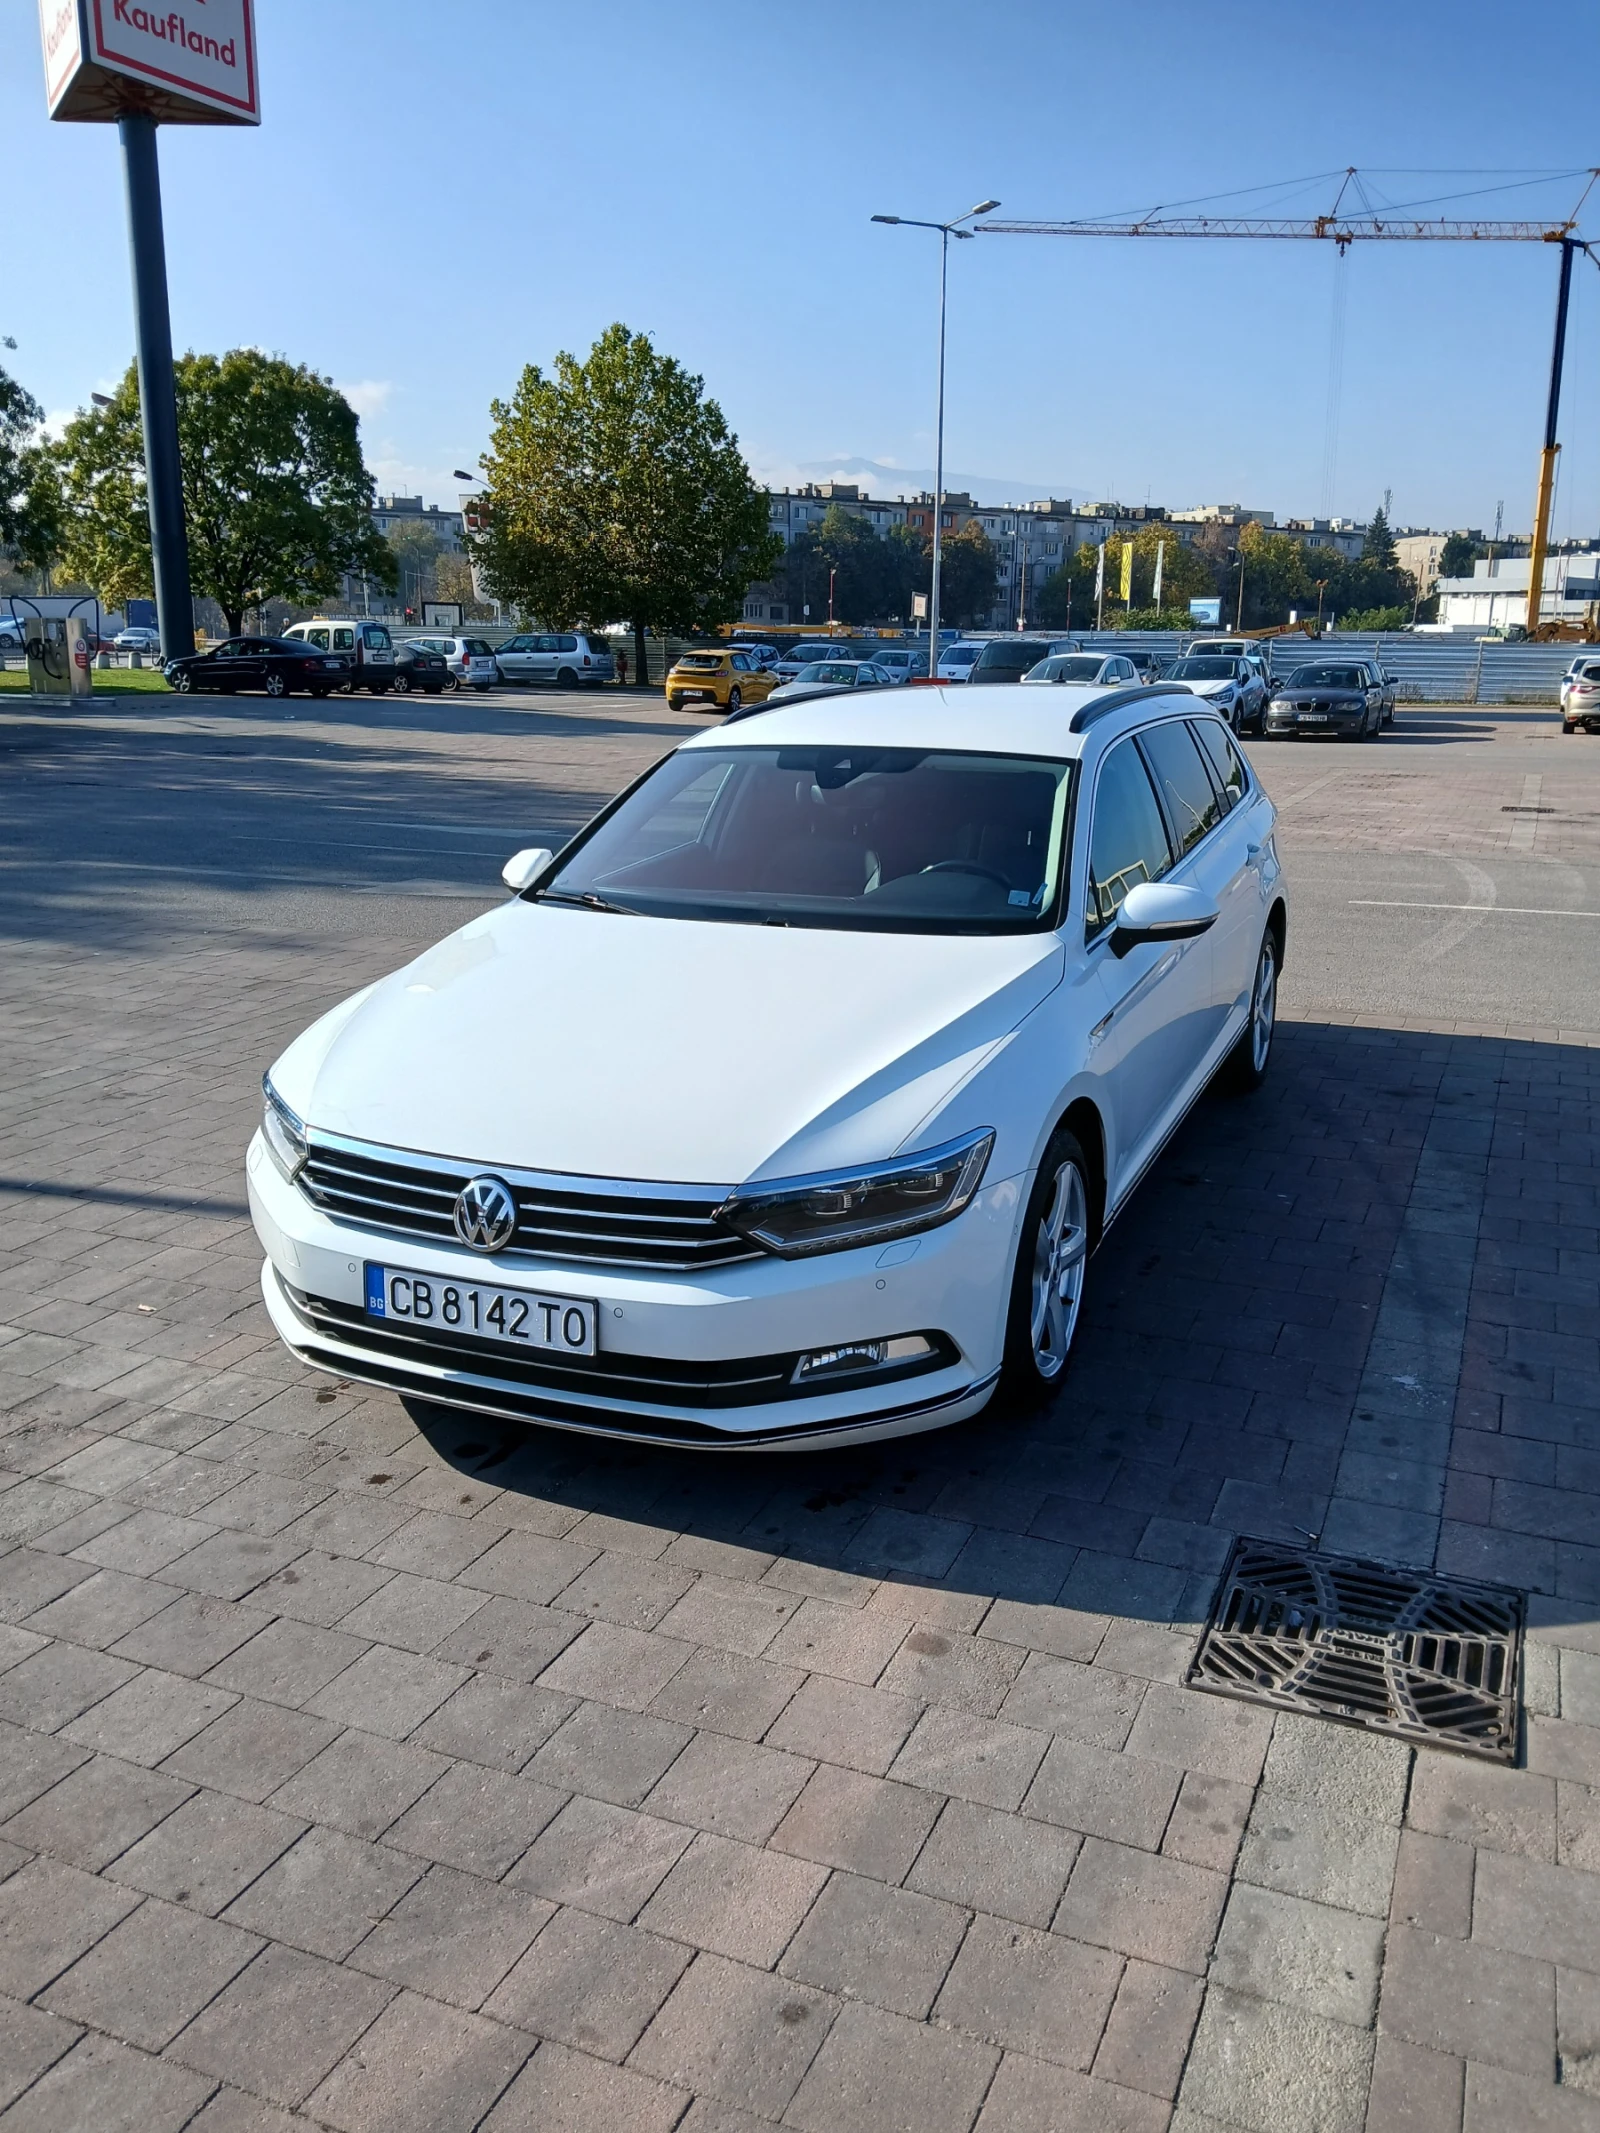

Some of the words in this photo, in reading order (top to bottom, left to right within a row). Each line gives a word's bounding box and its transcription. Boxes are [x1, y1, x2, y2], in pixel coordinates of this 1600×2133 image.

[113, 0, 236, 67] Kaufland
[454, 1178, 515, 1252] VW
[369, 1296, 384, 1310] BG
